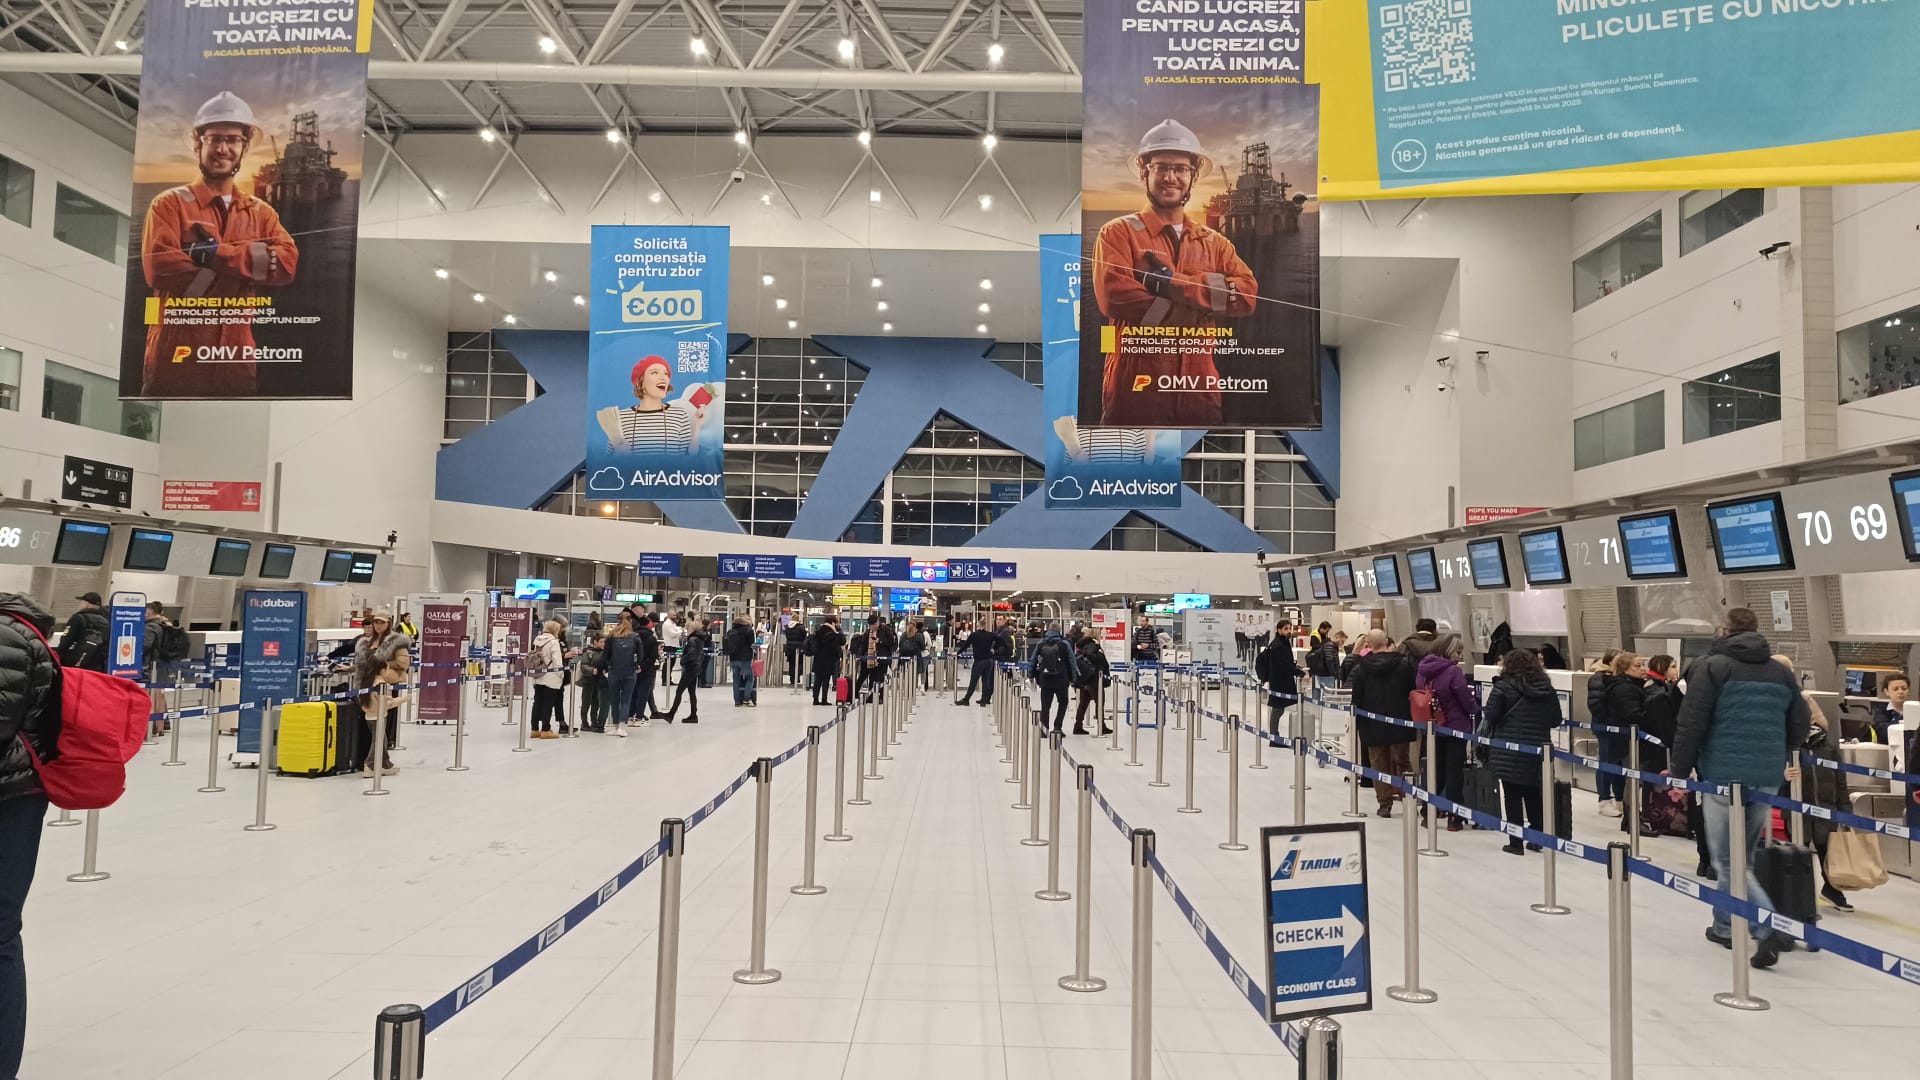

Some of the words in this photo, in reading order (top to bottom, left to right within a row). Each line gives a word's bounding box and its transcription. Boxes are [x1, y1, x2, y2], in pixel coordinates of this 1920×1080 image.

[1204, 0, 1300, 14] LUCREZI
[228, 9, 319, 25] LUCREZI
[323, 8, 354, 22] CU
[1561, 4, 1714, 43] PLICULEȚE
[1721, 0, 1763, 20] CU
[1121, 18, 1214, 32] PENTRU
[1217, 15, 1300, 35] ACASĂ,
[212, 25, 281, 44] TOATĂ
[285, 26, 353, 42] INIMA.
[1168, 37, 1264, 52] LUCREZI
[1268, 37, 1300, 52] CU
[1153, 52, 1226, 70] TOATĂ
[1229, 56, 1300, 71] INIMA.
[1154, 75, 1189, 84] ACASĂ
[1190, 76, 1216, 84] ESTE
[1217, 75, 1249, 84] TOATĂ
[1435, 140, 1464, 150] Acest
[1465, 136, 1501, 147] produs
[1502, 131, 1540, 142] conține
[1541, 124, 1585, 137] nicotină.
[1478, 142, 1530, 157] generează
[1531, 141, 1544, 149] un
[1546, 137, 1569, 148] grad
[1571, 134, 1604, 145] ridicat
[1606, 131, 1619, 139] de
[1621, 124, 1685, 139] dependență.
[1397, 149, 1422, 163] 18+
[633, 238, 688, 250] Solicită
[614, 251, 706, 266] compensația
[618, 267, 667, 278] pentru
[670, 265, 702, 277] zbor
[163, 297, 222, 307] ANDREI
[224, 296, 272, 306] MARIN
[627, 297, 696, 316] €600
[163, 308, 219, 317] PETROLIST,
[219, 308, 264, 316] GORJEAN
[163, 317, 203, 325] INGINER
[1121, 326, 1180, 337] ANDREI
[1182, 327, 1233, 337] MARIN
[1121, 337, 1177, 346] PETROLIST,
[1178, 338, 1227, 346] GORJEAN
[1228, 338, 1238, 348] ȘI
[196, 345, 238, 360] OMV
[242, 345, 302, 359] Petrom
[1121, 346, 1162, 354] INGINER
[1163, 346, 1178, 354] DE
[1178, 347, 1212, 355] FORAJ
[1214, 347, 1256, 355] NEPTUN
[1157, 375, 1200, 390] OMV
[1205, 375, 1268, 390] Petrom
[630, 470, 722, 486] AirAdvisor
[1089, 479, 1178, 496] AirAdvisor
[1797, 510, 1833, 547] 70
[1850, 503, 1888, 542] 69
[0, 526, 22, 548] 86
[1571, 542, 1592, 566] 72
[1598, 537, 1621, 565] 71
[1439, 559, 1453, 579] 74
[1455, 556, 1471, 578] 73
[1355, 570, 1365, 588] 76
[1366, 569, 1377, 586] 75
[426, 611, 451, 619] QATAR
[1300, 857, 1342, 871] TAROM
[1275, 925, 1344, 944] CHECK-IN
[1276, 980, 1324, 996] ECONOMY
[1325, 977, 1357, 989] CLASS
